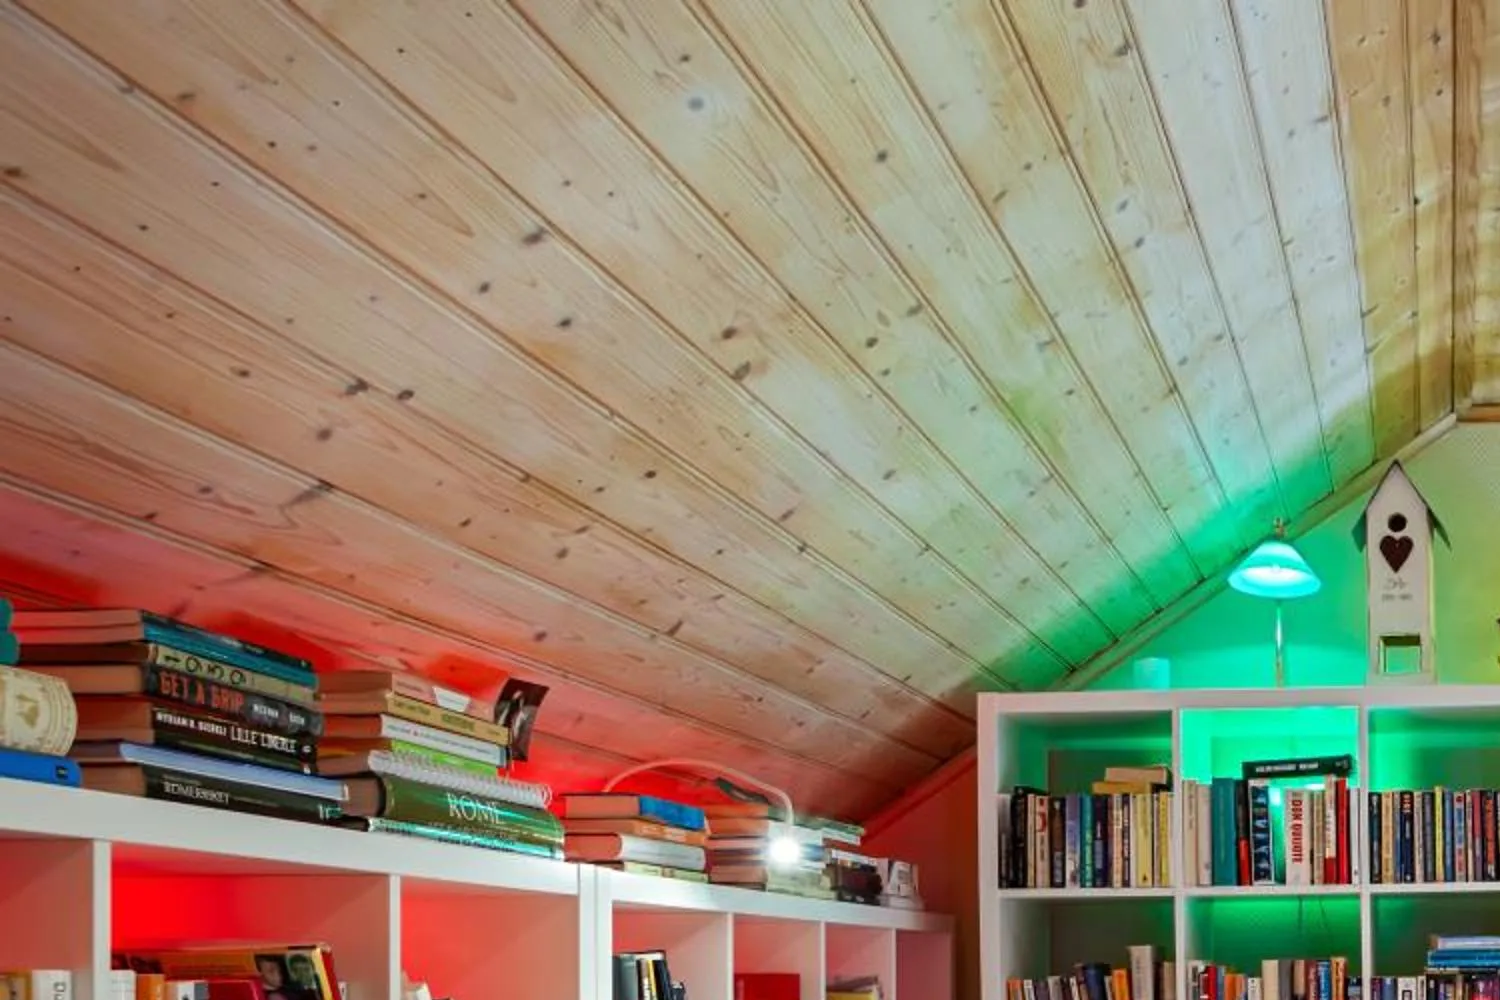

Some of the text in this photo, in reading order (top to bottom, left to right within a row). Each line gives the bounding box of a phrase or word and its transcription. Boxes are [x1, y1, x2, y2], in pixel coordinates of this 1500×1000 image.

[159, 671, 246, 710] GET A GRIP
[1291, 799, 1303, 820] DON
